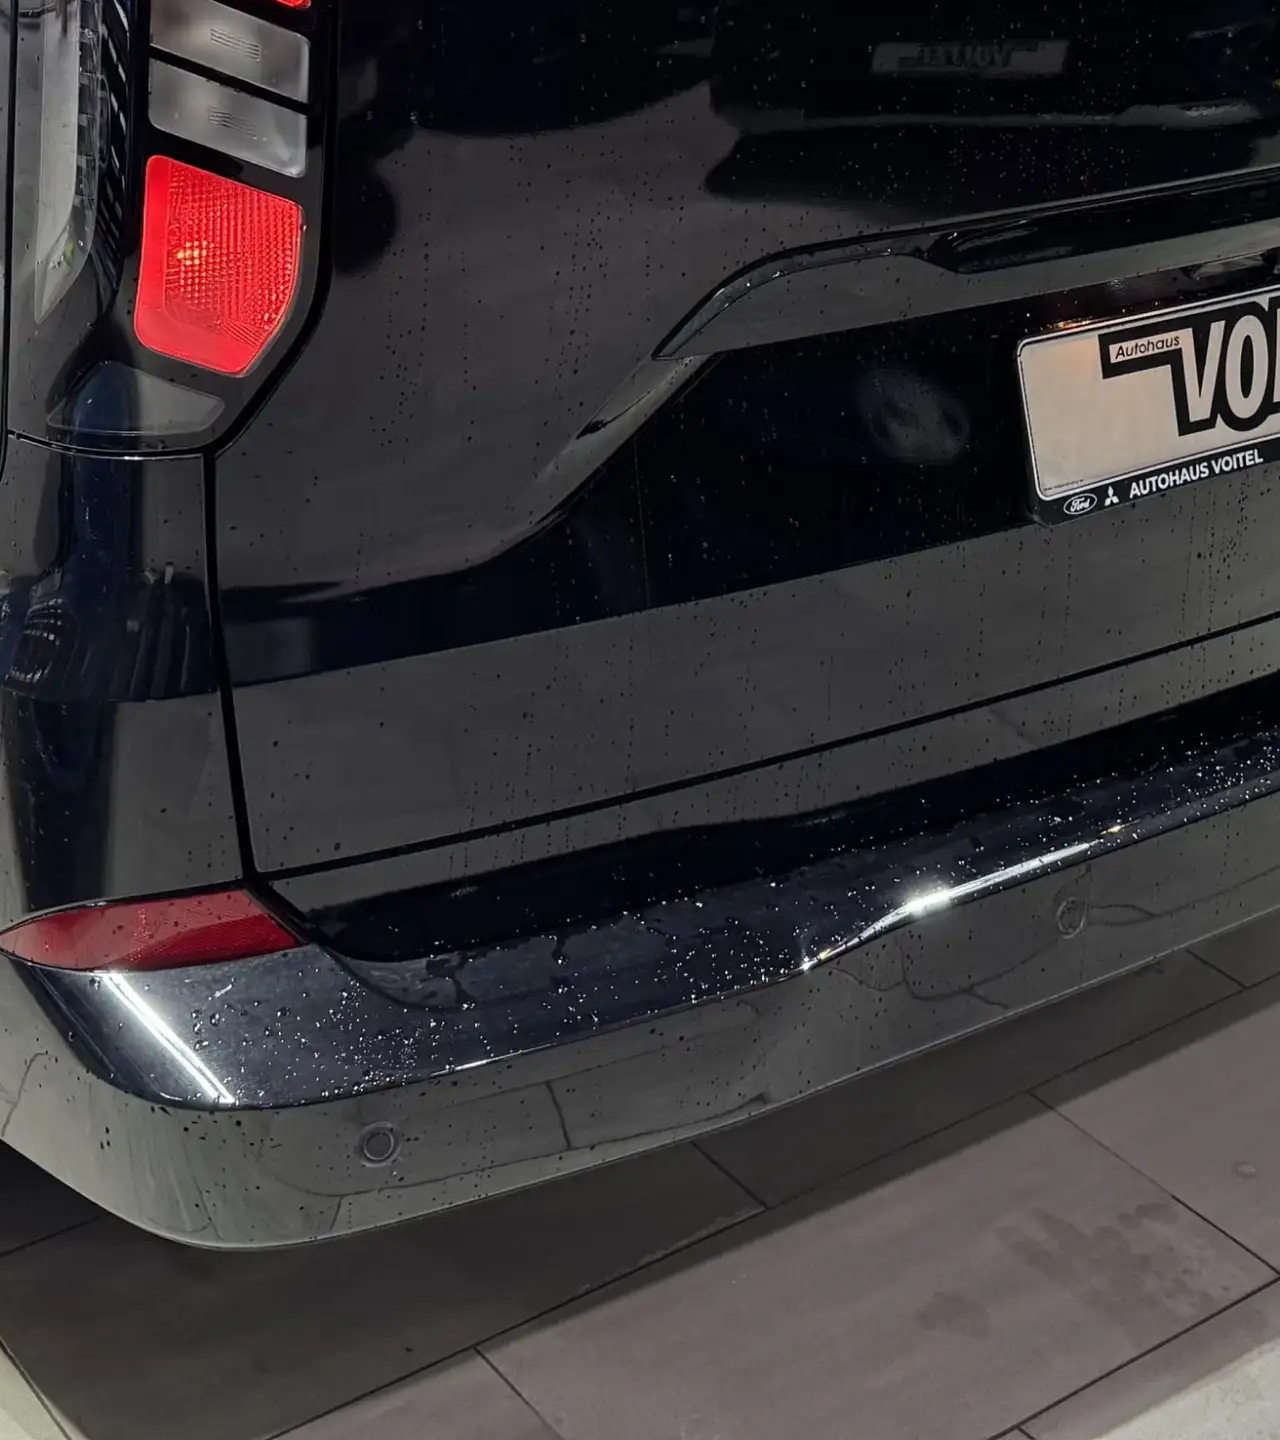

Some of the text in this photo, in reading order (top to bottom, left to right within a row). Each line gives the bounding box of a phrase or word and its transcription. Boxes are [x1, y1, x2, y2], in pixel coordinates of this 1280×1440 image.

[1115, 334, 1181, 360] Autohaus
[1129, 448, 1264, 500] AUTOHAUS VOITEL
